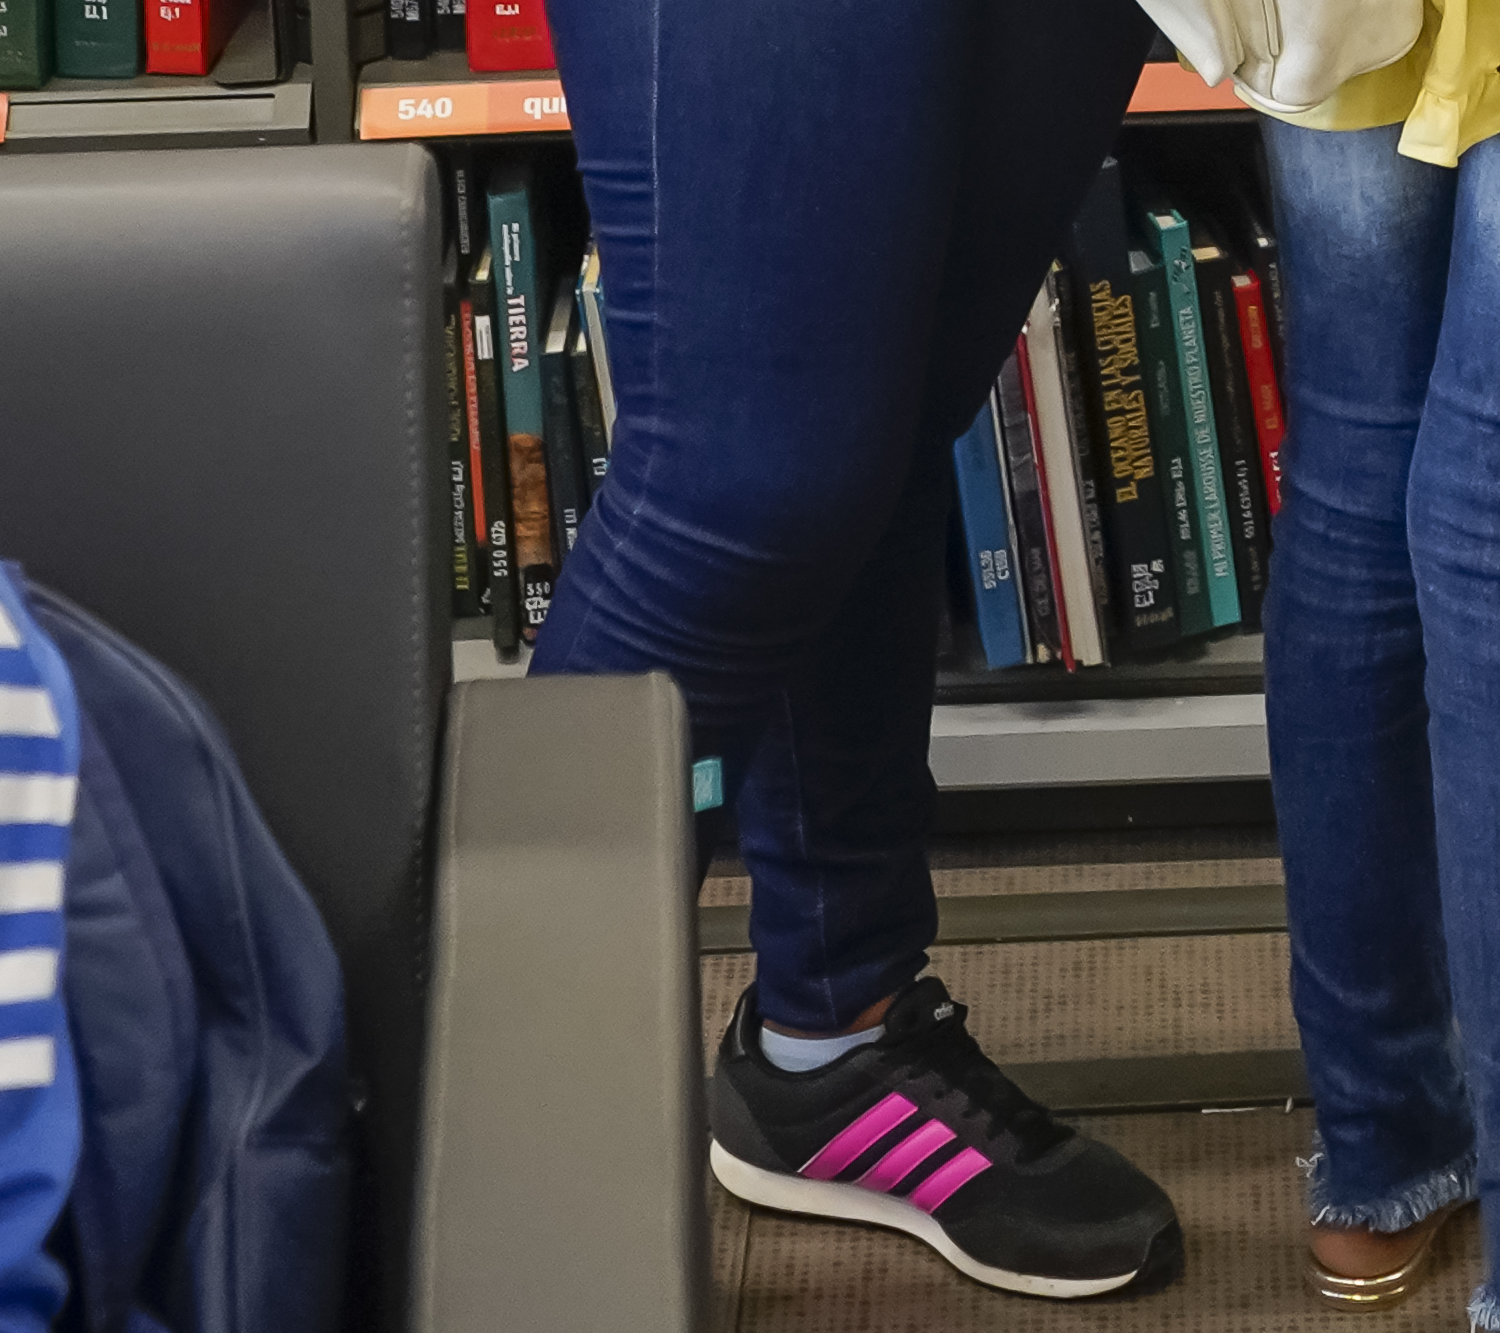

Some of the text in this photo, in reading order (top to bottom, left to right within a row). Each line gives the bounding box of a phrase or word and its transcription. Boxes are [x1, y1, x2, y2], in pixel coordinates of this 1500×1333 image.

[397, 96, 453, 121] 540
[506, 295, 529, 373] TIERRA
[1090, 279, 1116, 351] CIENCIAS
[1110, 294, 1139, 368] SOCIALES
[1180, 306, 1202, 363] PLANETA
[1099, 354, 1122, 385] LAS
[1188, 367, 1210, 424] NUESTRO
[1102, 387, 1124, 411] EN
[1122, 390, 1154, 479] NATURALES
[1196, 425, 1214, 444] DE
[1116, 482, 1139, 503] EL
[1200, 446, 1224, 510] LAROUSSE
[1208, 511, 1229, 558] PRIMER
